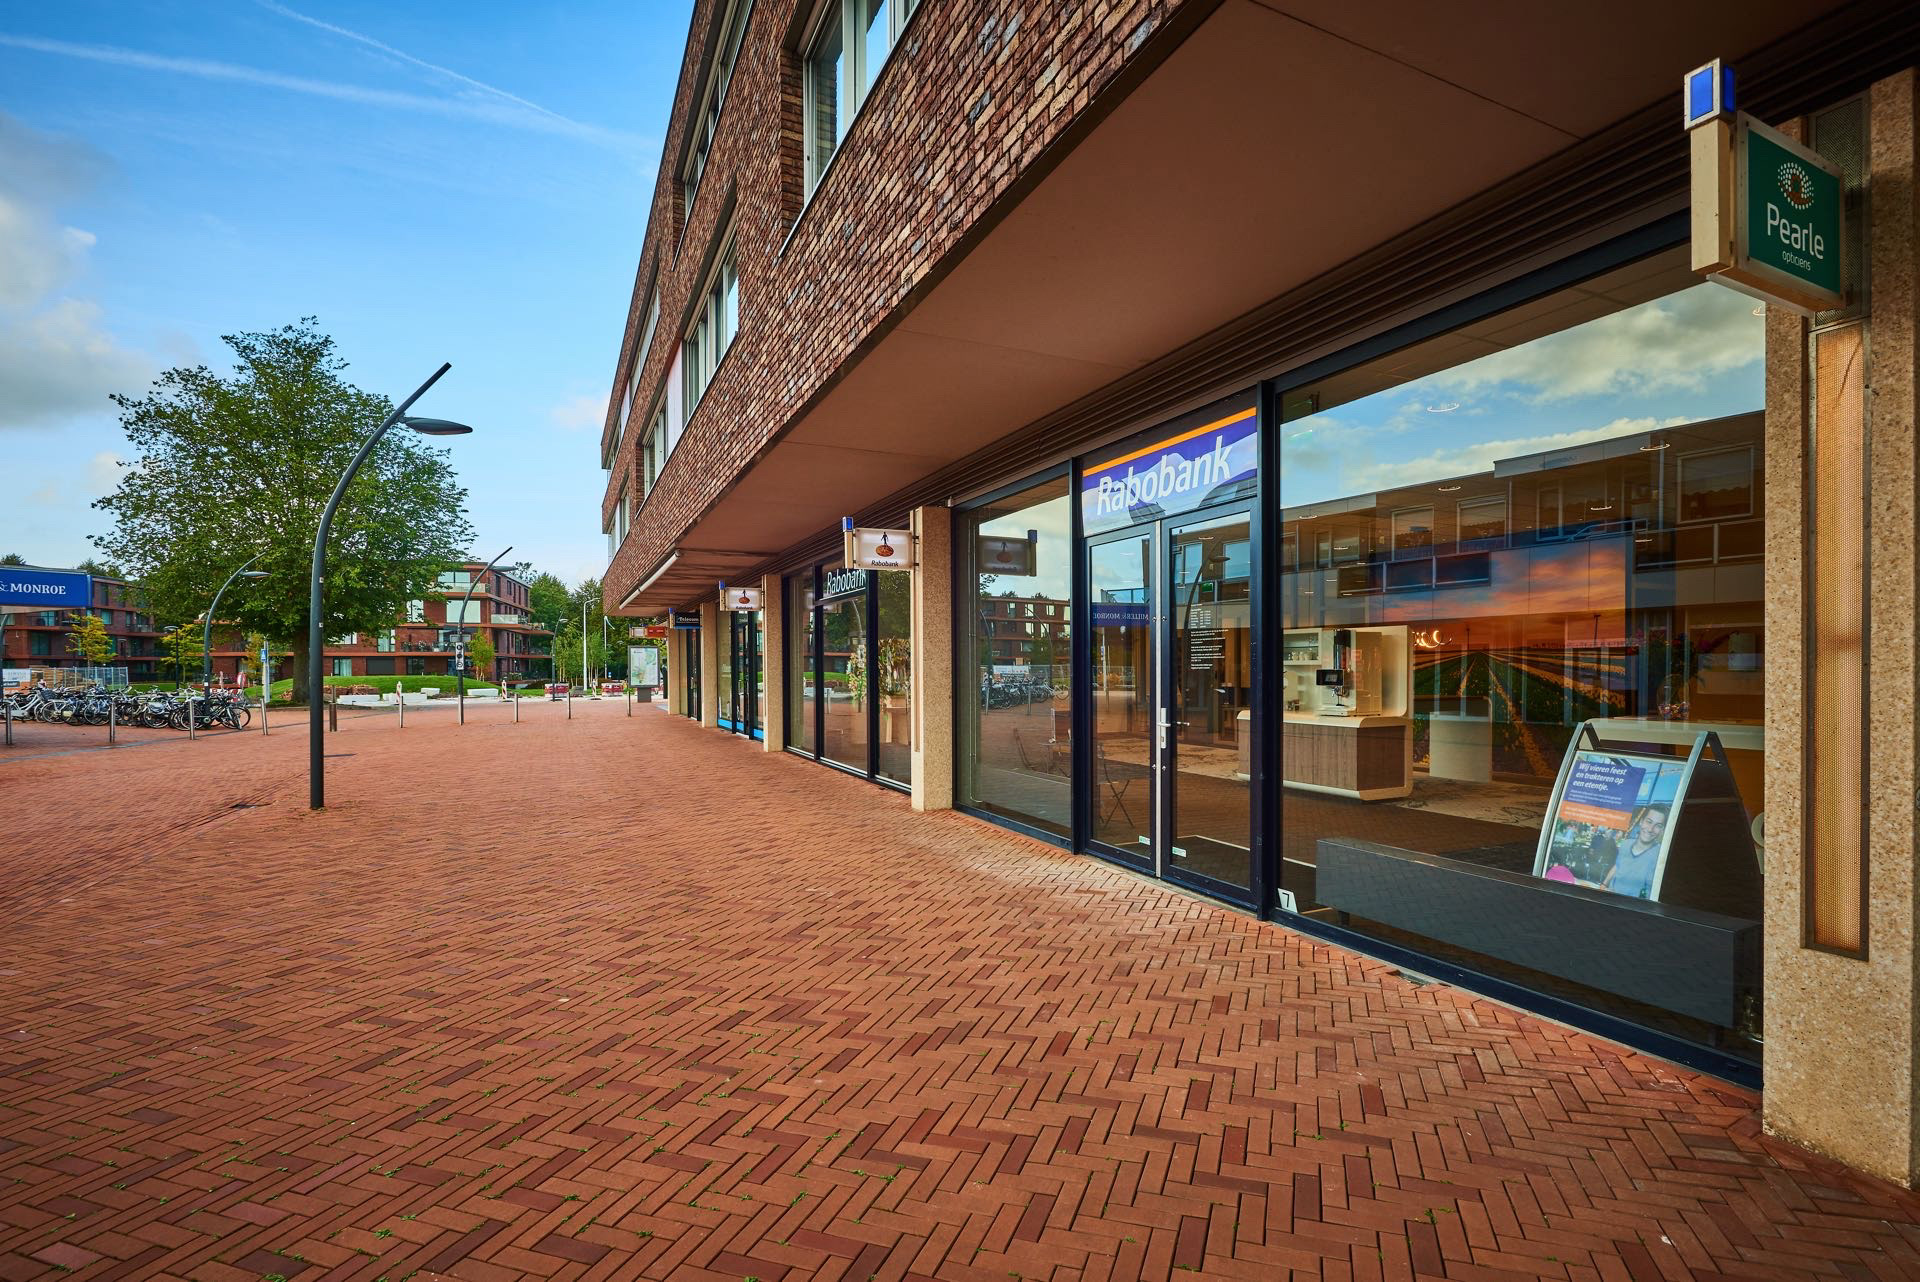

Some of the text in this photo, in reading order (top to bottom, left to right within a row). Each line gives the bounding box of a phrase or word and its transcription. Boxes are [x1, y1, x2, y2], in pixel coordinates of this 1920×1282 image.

[1767, 202, 1824, 259] Pearle
[1782, 250, 1811, 271] opticiens
[1097, 434, 1233, 516] Rabobank
[871, 559, 899, 568] Rabobank
[10, 582, 67, 595] MONROE
[826, 568, 867, 595] Rabobank
[1578, 762, 1628, 776] Wij vieren feest
[1584, 773, 1614, 783] trakteren
[1614, 777, 1625, 786] op
[1584, 782, 1609, 792] etentje.
[1281, 892, 1290, 908] 7
